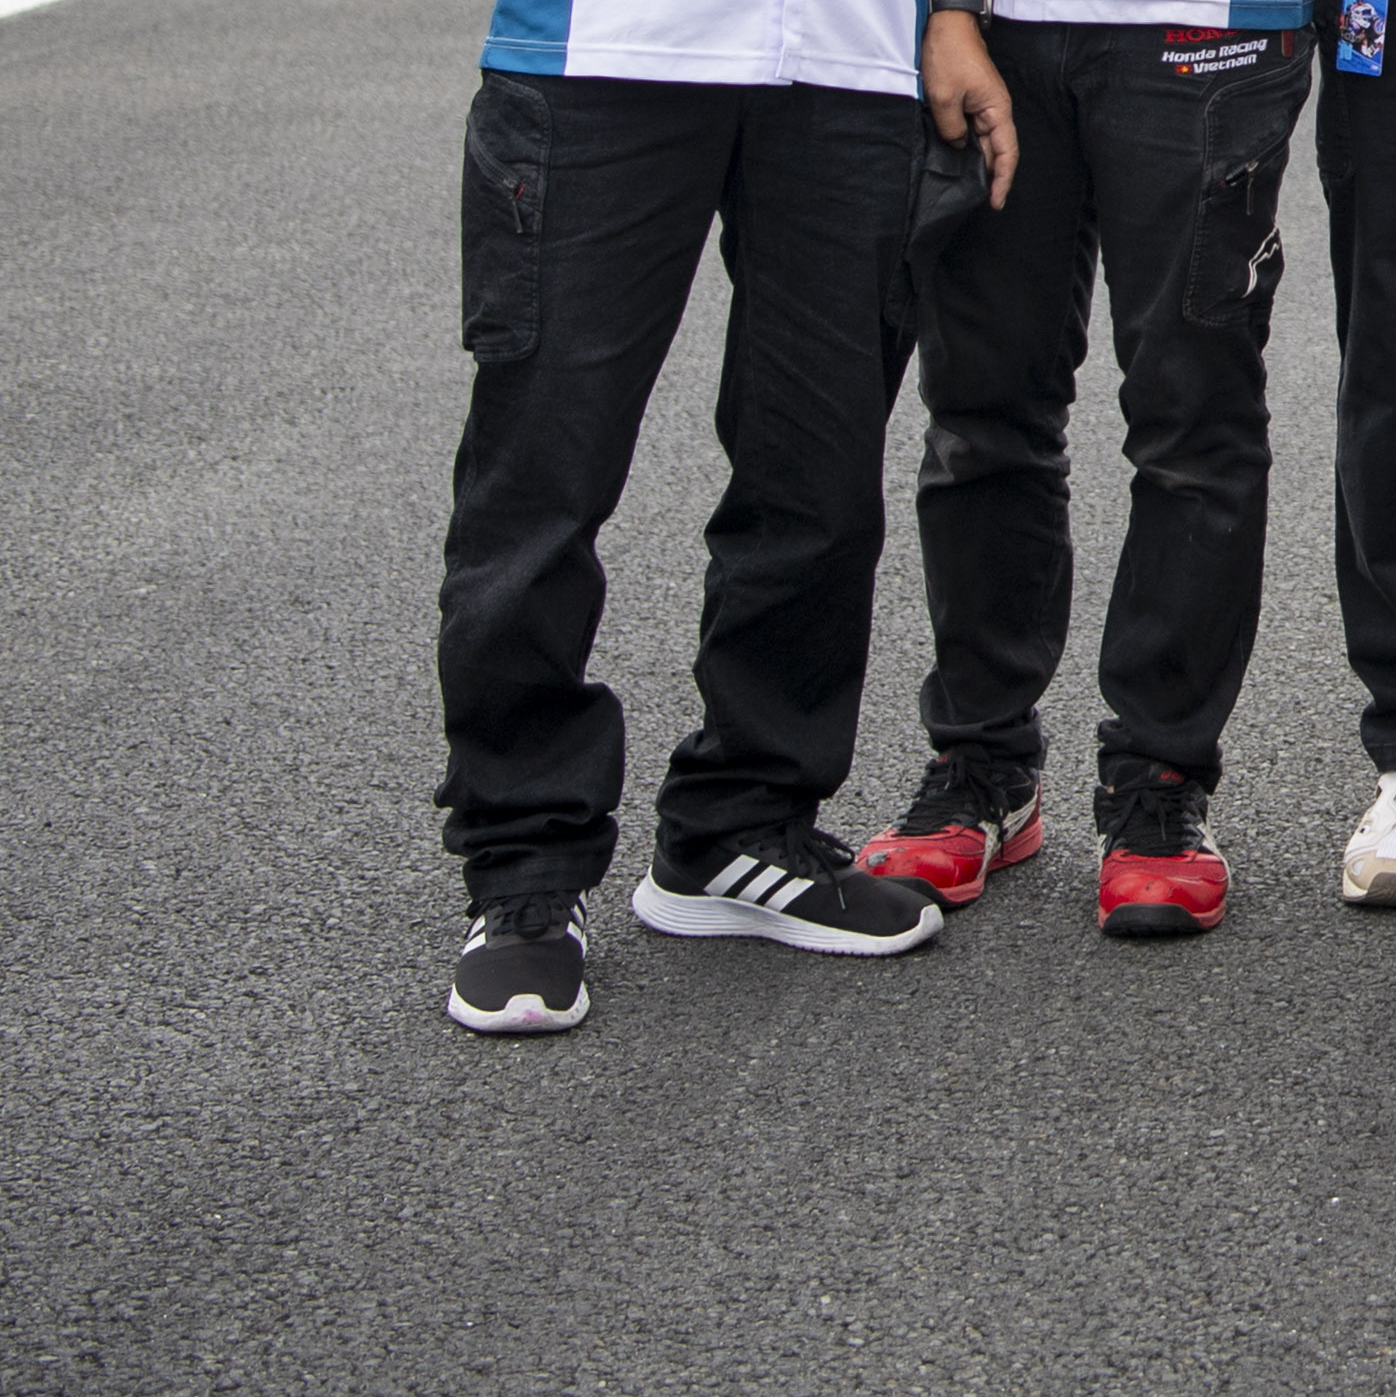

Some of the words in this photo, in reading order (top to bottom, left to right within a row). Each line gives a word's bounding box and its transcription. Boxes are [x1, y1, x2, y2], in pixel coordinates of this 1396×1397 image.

[1161, 49, 1217, 63] Honda
[1218, 38, 1268, 58] Racing
[1193, 53, 1258, 74] Vietnam
